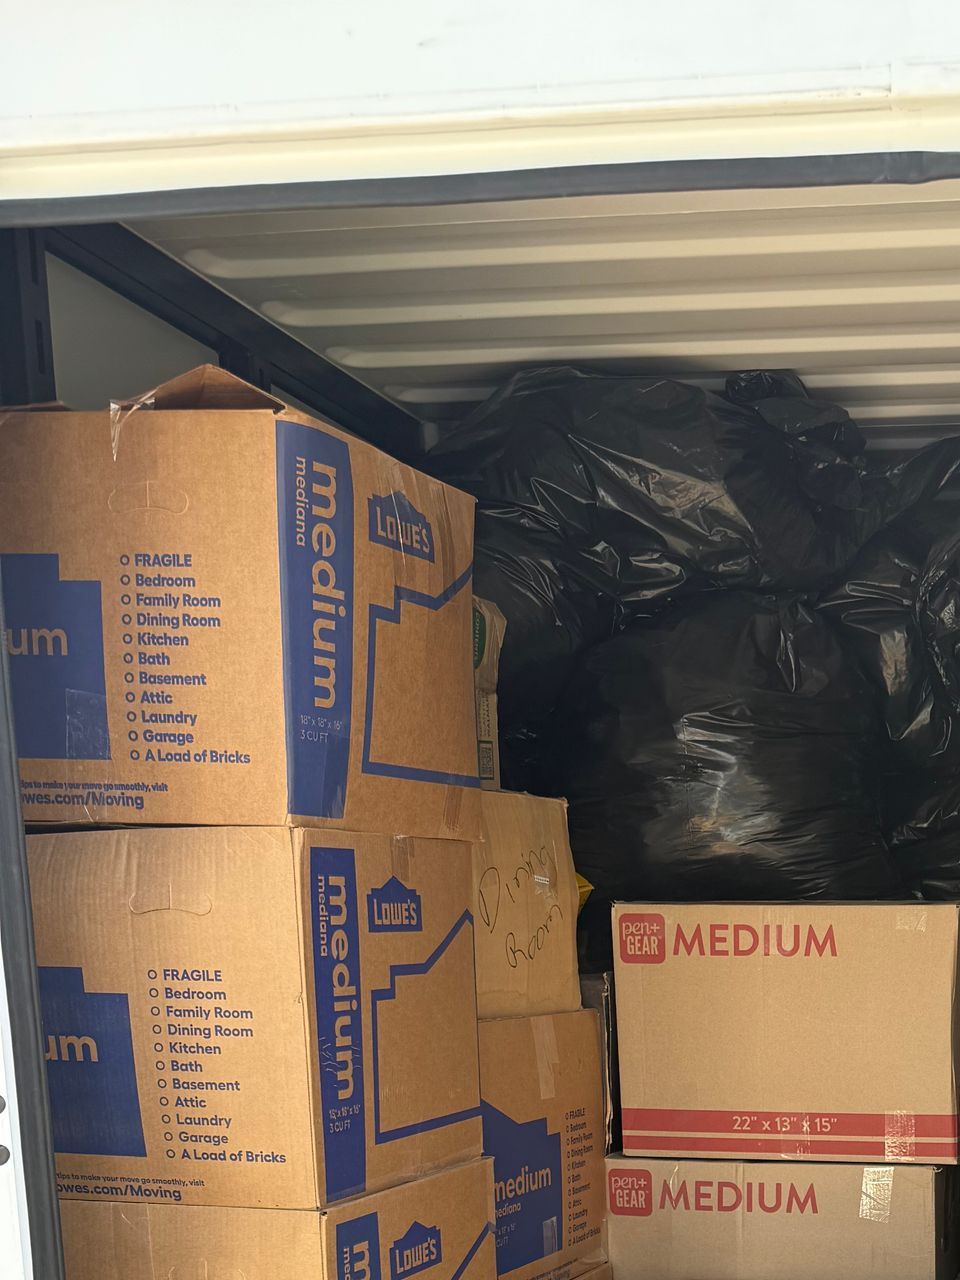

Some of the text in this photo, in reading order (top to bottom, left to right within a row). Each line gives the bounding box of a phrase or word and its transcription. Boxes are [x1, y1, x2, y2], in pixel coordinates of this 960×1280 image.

[295, 456, 306, 547] mediana
[134, 554, 192, 567] FRAGILE
[136, 574, 195, 587] Bedroom
[311, 461, 346, 709] medium
[137, 633, 189, 646] Kitchen
[139, 672, 206, 685] Basement
[141, 711, 197, 726] Laundry
[478, 846, 555, 934] Dining
[318, 875, 328, 957] mediana
[374, 900, 417, 926] LOWE'S
[506, 904, 563, 969] Room
[673, 924, 837, 957] MEDIUM
[626, 936, 658, 954] GEAR
[163, 969, 222, 982] FRAGILE
[165, 987, 226, 1001] Bedroom
[329, 875, 358, 1100] medium
[166, 1006, 253, 1020] Family Room
[168, 1024, 254, 1038] Dining Room
[170, 1042, 221, 1055] Kitchen
[171, 1060, 202, 1072] Bath
[172, 1078, 240, 1091] Basement
[175, 1096, 207, 1108] Attic
[176, 1114, 232, 1128] Laundry
[732, 1116, 758, 1131] 22"
[762, 1121, 771, 1131] x
[775, 1117, 797, 1131] 13"
[815, 1118, 838, 1132] 15"
[179, 1132, 228, 1146] Garage
[182, 1149, 286, 1163] A Load of Bricks
[57, 1184, 182, 1200] owes.com/Moving
[616, 1190, 646, 1208] GEAR
[659, 1179, 818, 1214] MEDIUM
[396, 1238, 436, 1274] LOWE'S
